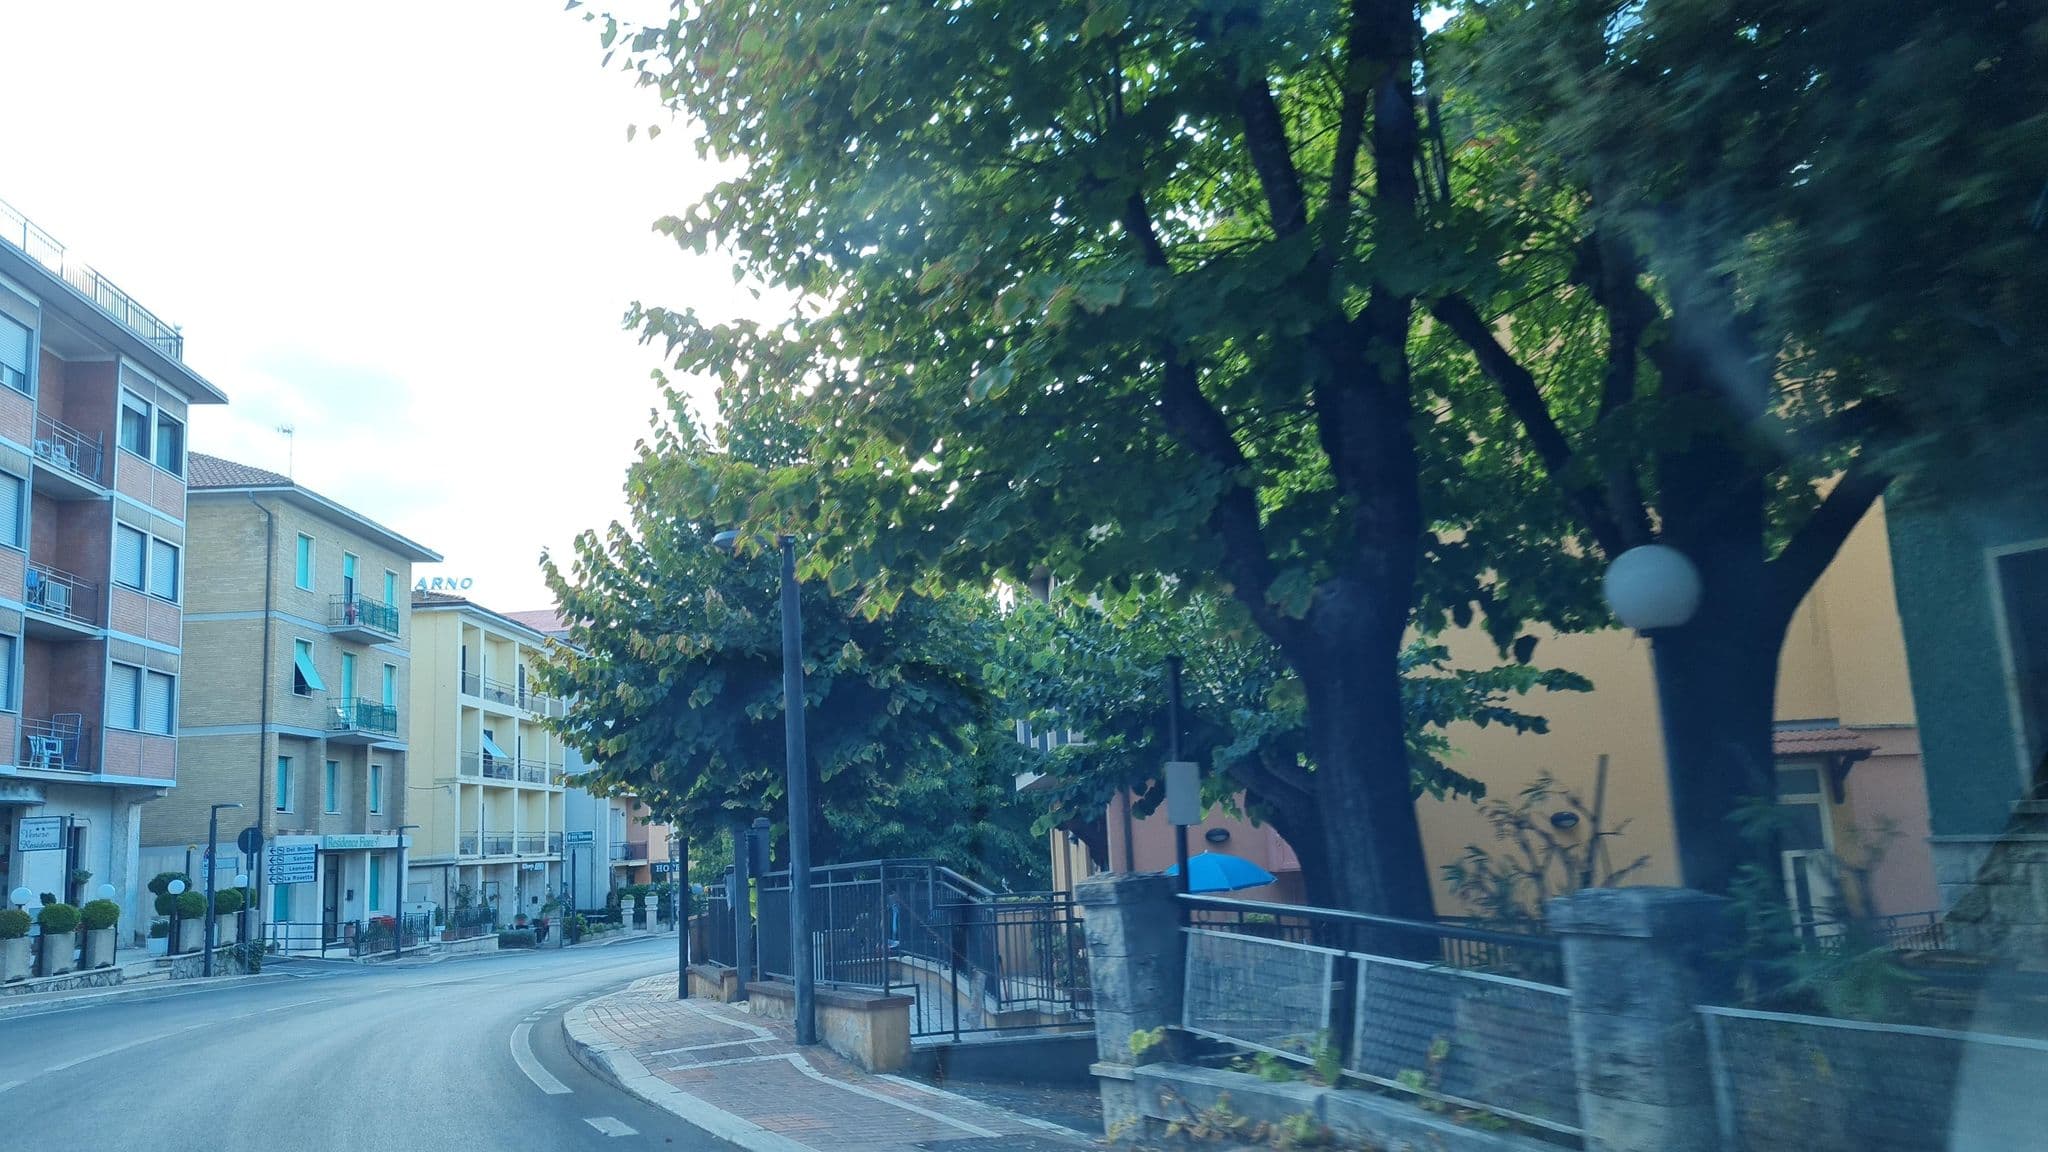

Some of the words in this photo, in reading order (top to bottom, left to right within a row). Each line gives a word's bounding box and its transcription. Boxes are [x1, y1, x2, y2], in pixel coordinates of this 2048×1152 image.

[415, 577, 473, 590] ARNO
[20, 840, 58, 849] Residence
[328, 836, 359, 848] Residence
